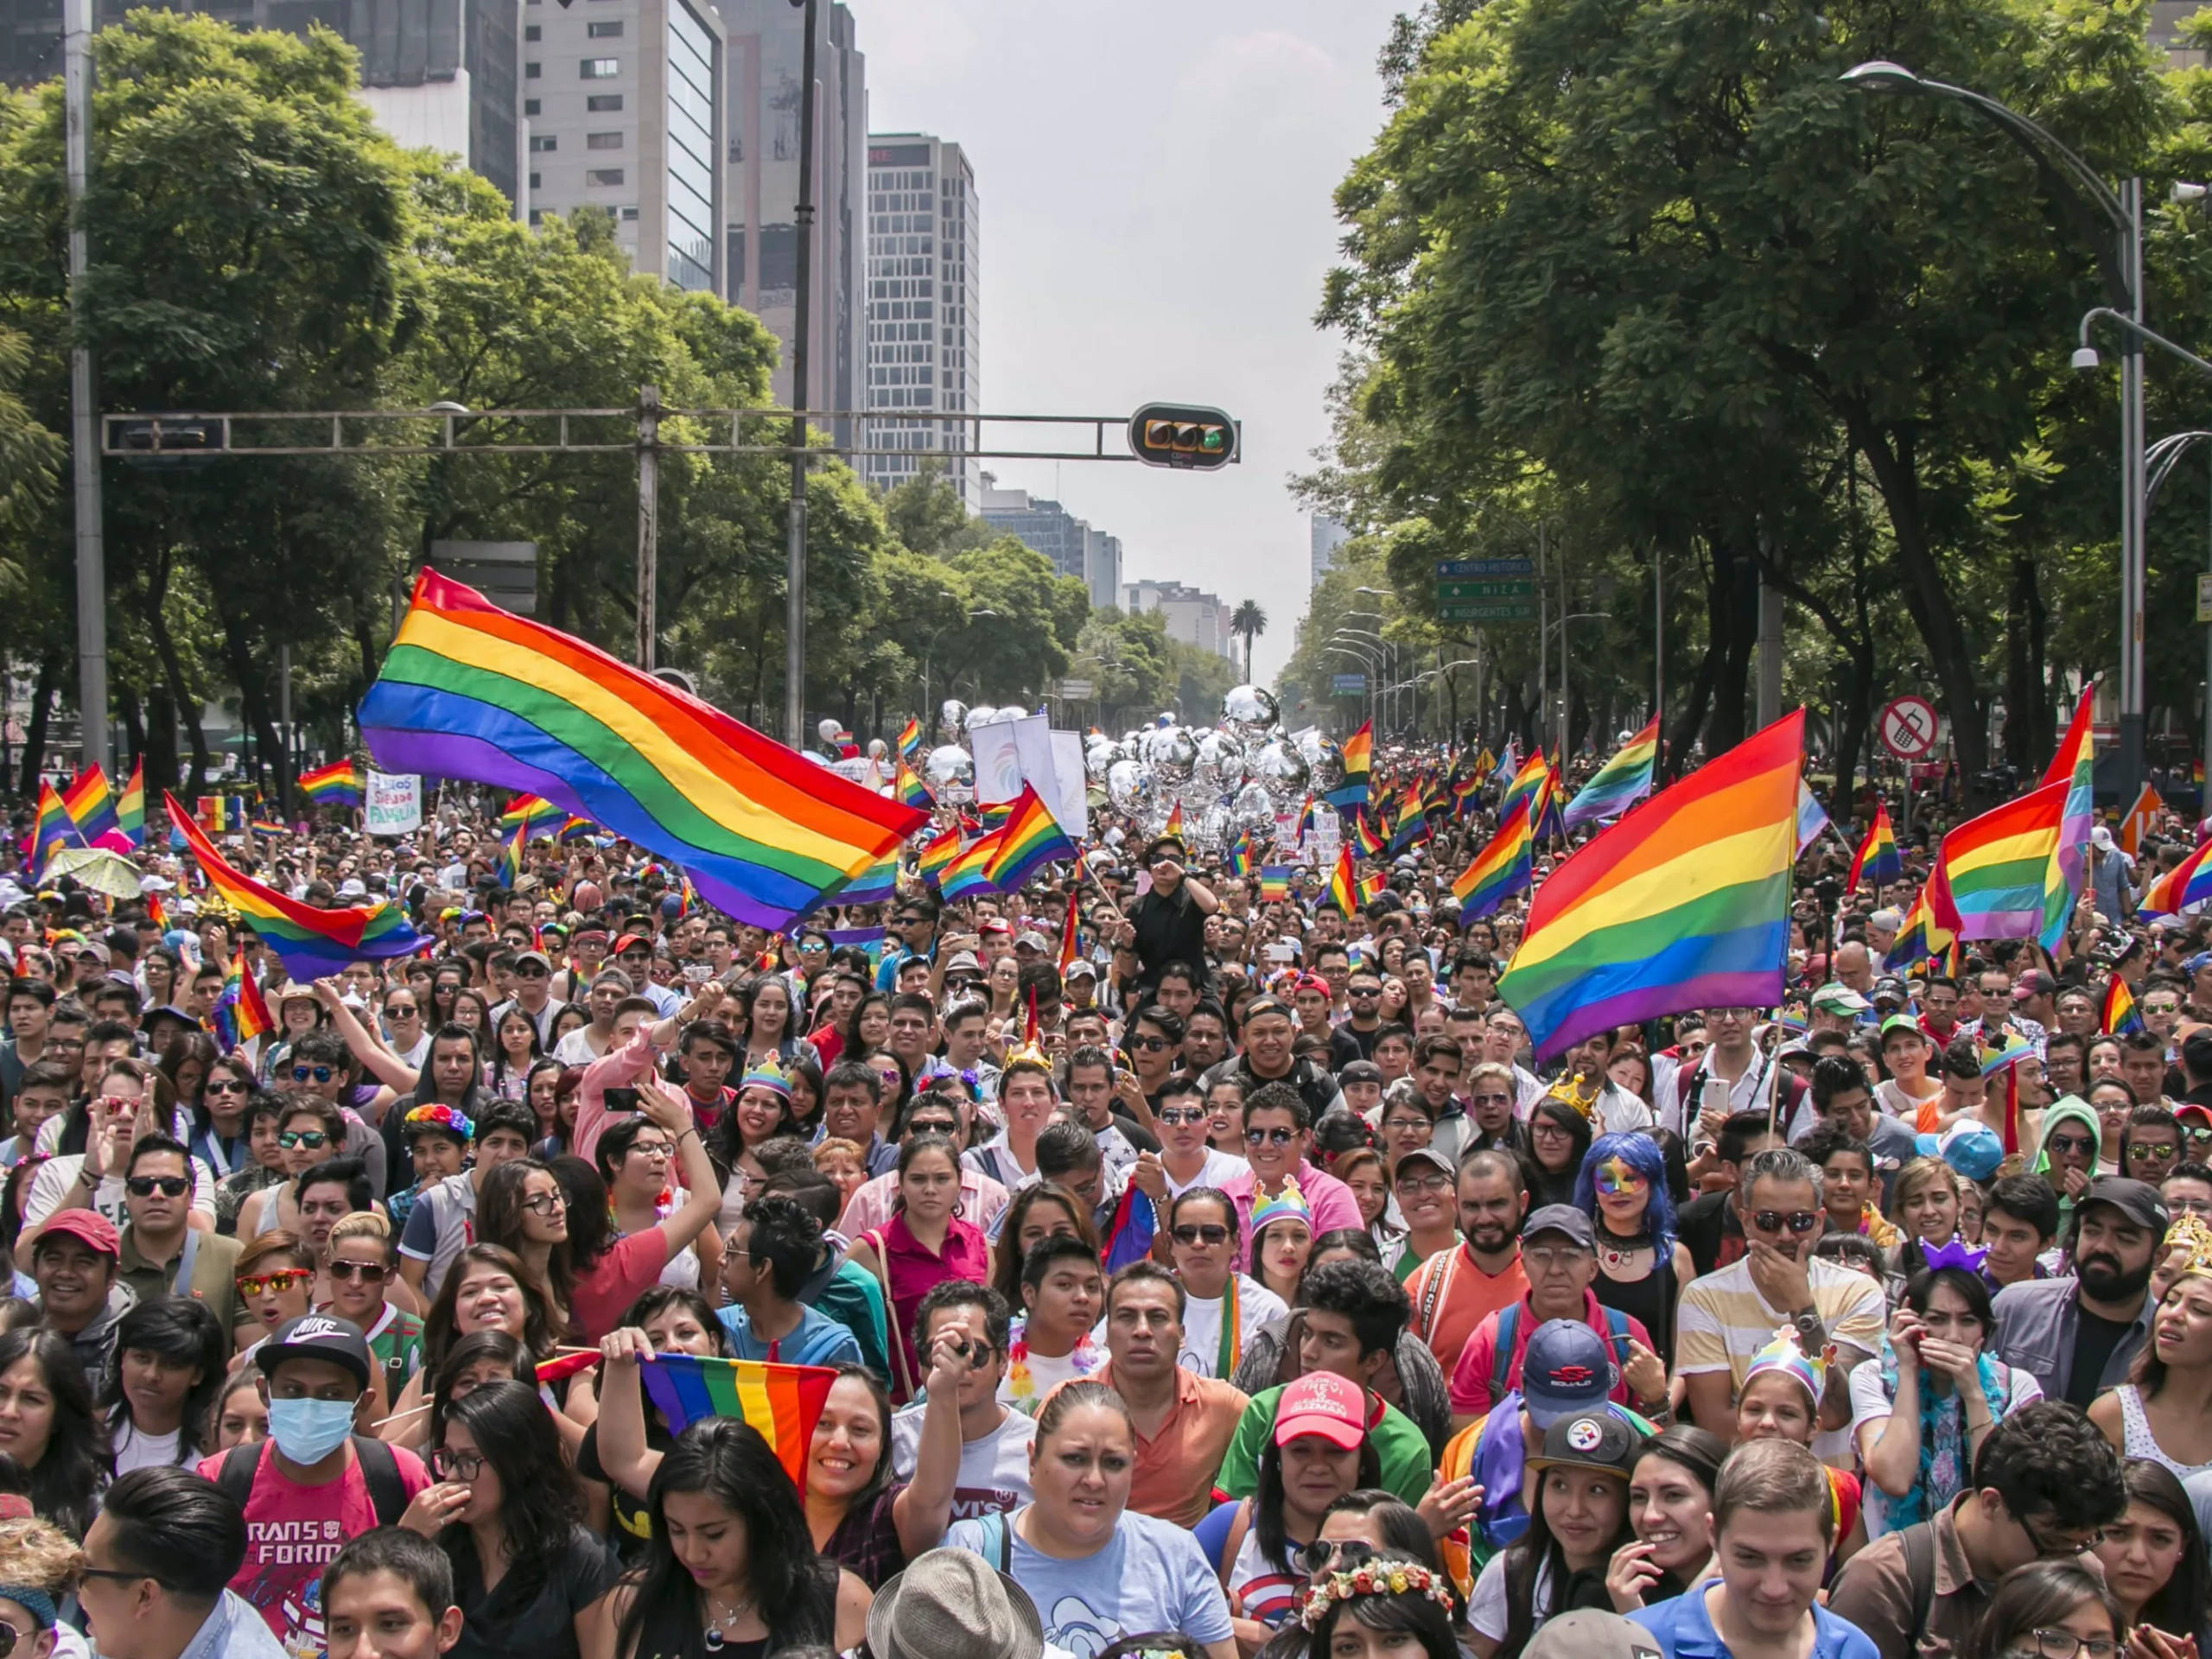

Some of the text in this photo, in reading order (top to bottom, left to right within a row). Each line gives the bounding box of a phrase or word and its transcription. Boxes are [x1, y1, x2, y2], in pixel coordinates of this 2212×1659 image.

[1454, 563, 1485, 573] CENTRO
[1455, 607, 1530, 618] INSURGENTES SUR
[296, 1317, 337, 1334] NIKE
[1289, 1402, 1348, 1419] GUZMAN
[247, 1521, 319, 1541] RANS
